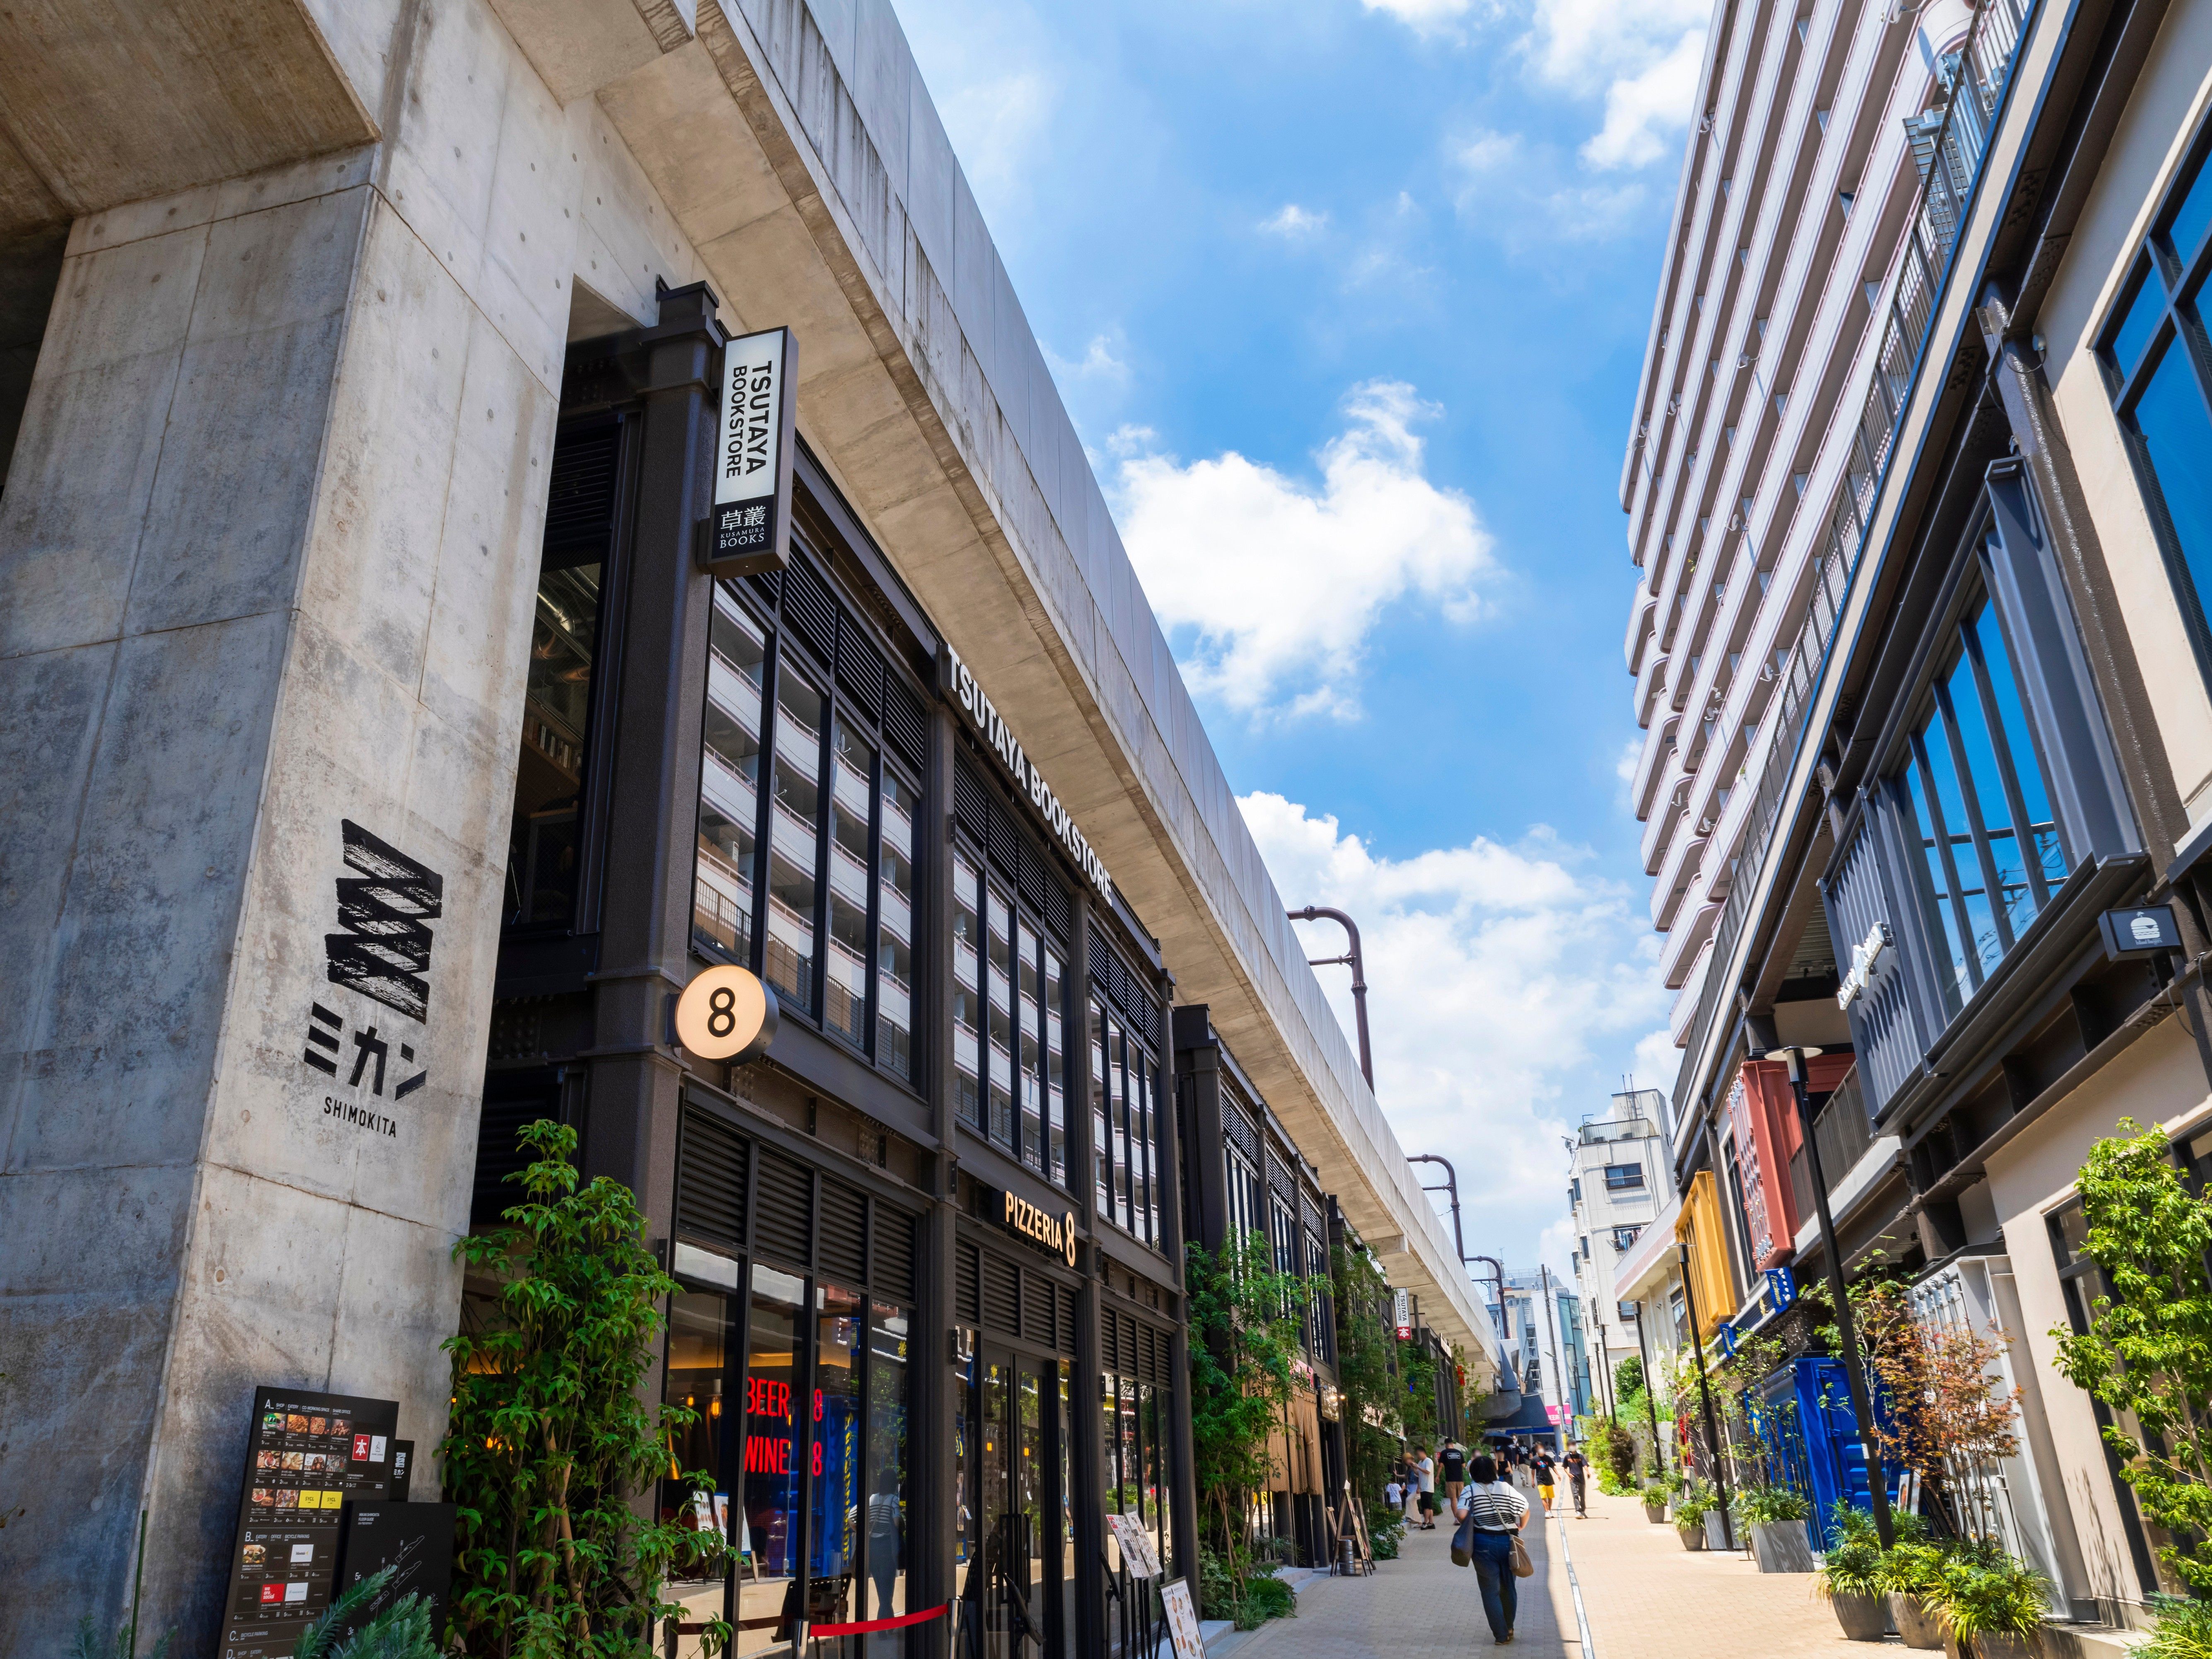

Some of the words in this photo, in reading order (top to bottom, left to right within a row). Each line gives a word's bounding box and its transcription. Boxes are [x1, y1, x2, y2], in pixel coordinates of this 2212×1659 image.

[726, 365, 747, 479] BOOKSTORE
[746, 360, 772, 475] TSUTAYA
[720, 505, 766, 531] 草叢
[720, 527, 765, 539] KUSAMURA
[720, 533, 765, 549] BOOKS
[947, 643, 1027, 790] TSUTAYA
[1031, 764, 1112, 907] BOOKSTORE
[708, 987, 735, 1037] 8
[304, 1001, 427, 1101] ミカン
[324, 1097, 396, 1138] SHIMOKITA
[1006, 1190, 1063, 1252] PIZZERIA
[1066, 1212, 1075, 1267] 8
[1399, 1328, 1409, 1337] 本
[747, 1376, 790, 1417] BEER
[814, 1388, 822, 1422] 8
[355, 1439, 367, 1456] 本
[745, 1435, 789, 1474] WINE
[812, 1441, 822, 1476] 8
